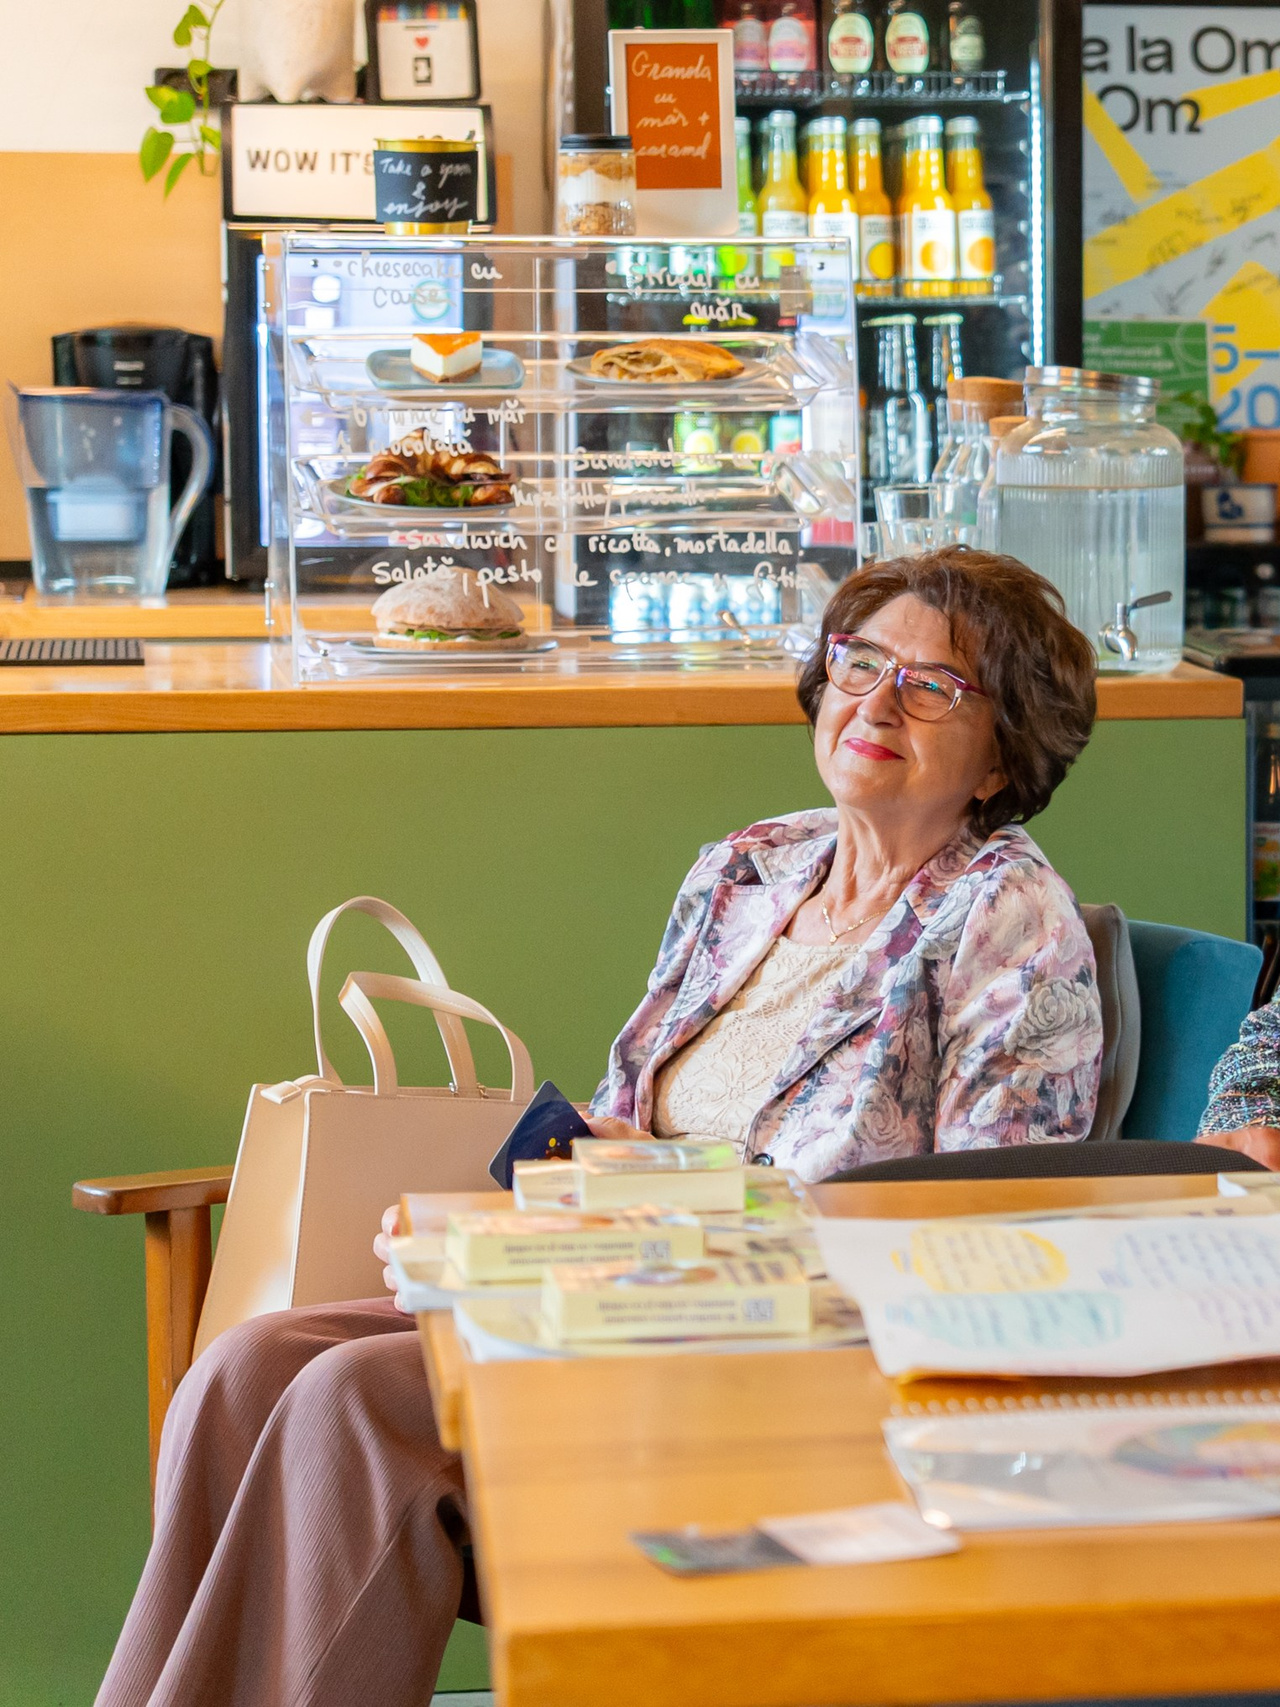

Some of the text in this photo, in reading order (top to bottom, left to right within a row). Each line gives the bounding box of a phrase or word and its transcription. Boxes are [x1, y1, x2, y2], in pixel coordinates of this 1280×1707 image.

[1126, 25, 1174, 74] la
[631, 50, 712, 82] Granola
[1099, 84, 1204, 134] Om
[247, 149, 317, 173] WOW
[378, 157, 412, 177] Take
[382, 197, 469, 219] enjoy
[471, 262, 503, 280] cu
[735, 273, 760, 289] cu
[476, 559, 542, 609] pesto
